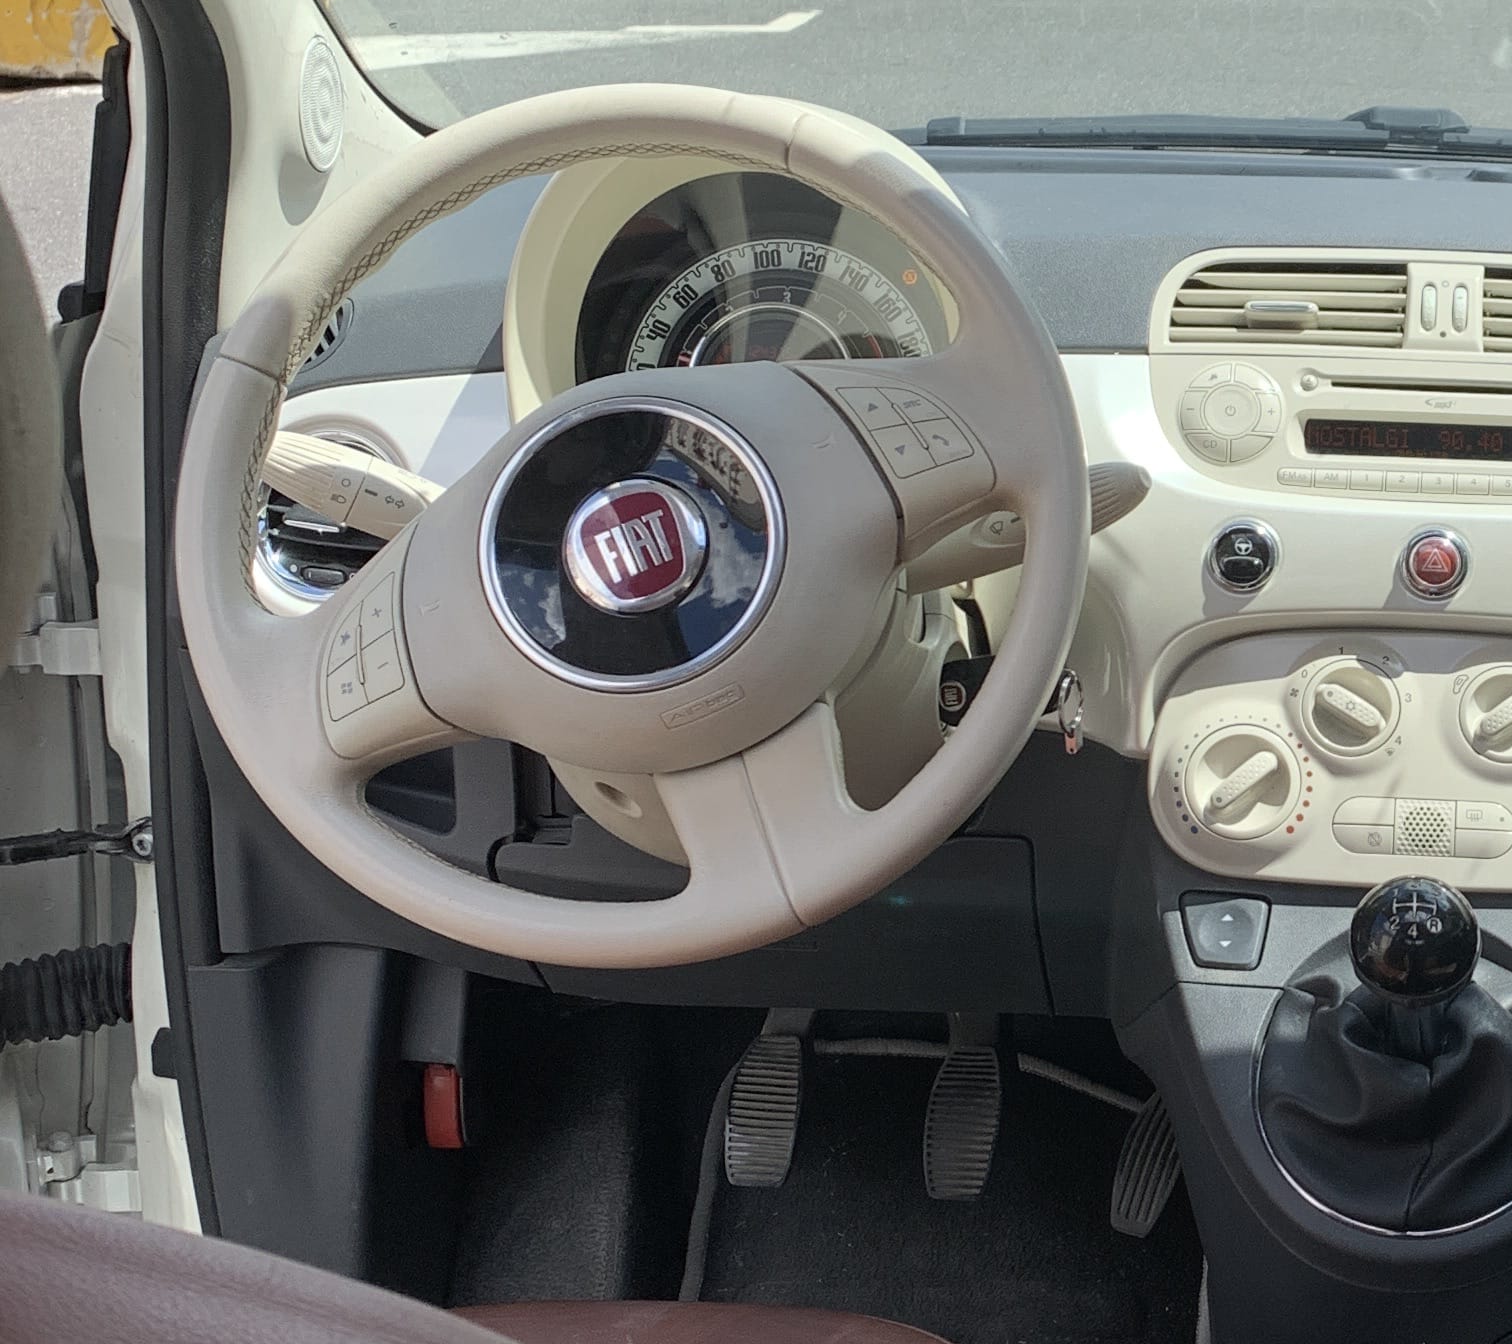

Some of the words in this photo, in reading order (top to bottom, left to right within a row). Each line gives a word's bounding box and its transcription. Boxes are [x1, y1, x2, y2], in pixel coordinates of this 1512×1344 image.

[753, 249, 782, 270] 100
[798, 251, 827, 273] 120
[710, 259, 737, 283] 80
[839, 265, 870, 293] 140
[672, 284, 699, 309] 60
[783, 291, 792, 304] 3
[873, 292, 902, 323] 160
[646, 319, 672, 341] 40
[1202, 439, 1218, 449] CD
[1323, 473, 1339, 481] AM
[1399, 474, 1406, 483] 2
[1436, 476, 1442, 485] 3
[1504, 479, 1512, 488] 5
[594, 509, 674, 584] FIAT
[1338, 646, 1344, 655] 1
[1382, 655, 1390, 666] 2
[1405, 693, 1412, 703] 3
[1394, 735, 1402, 745] 4
[1389, 916, 1401, 930] 2
[1407, 923, 1418, 938] 4
